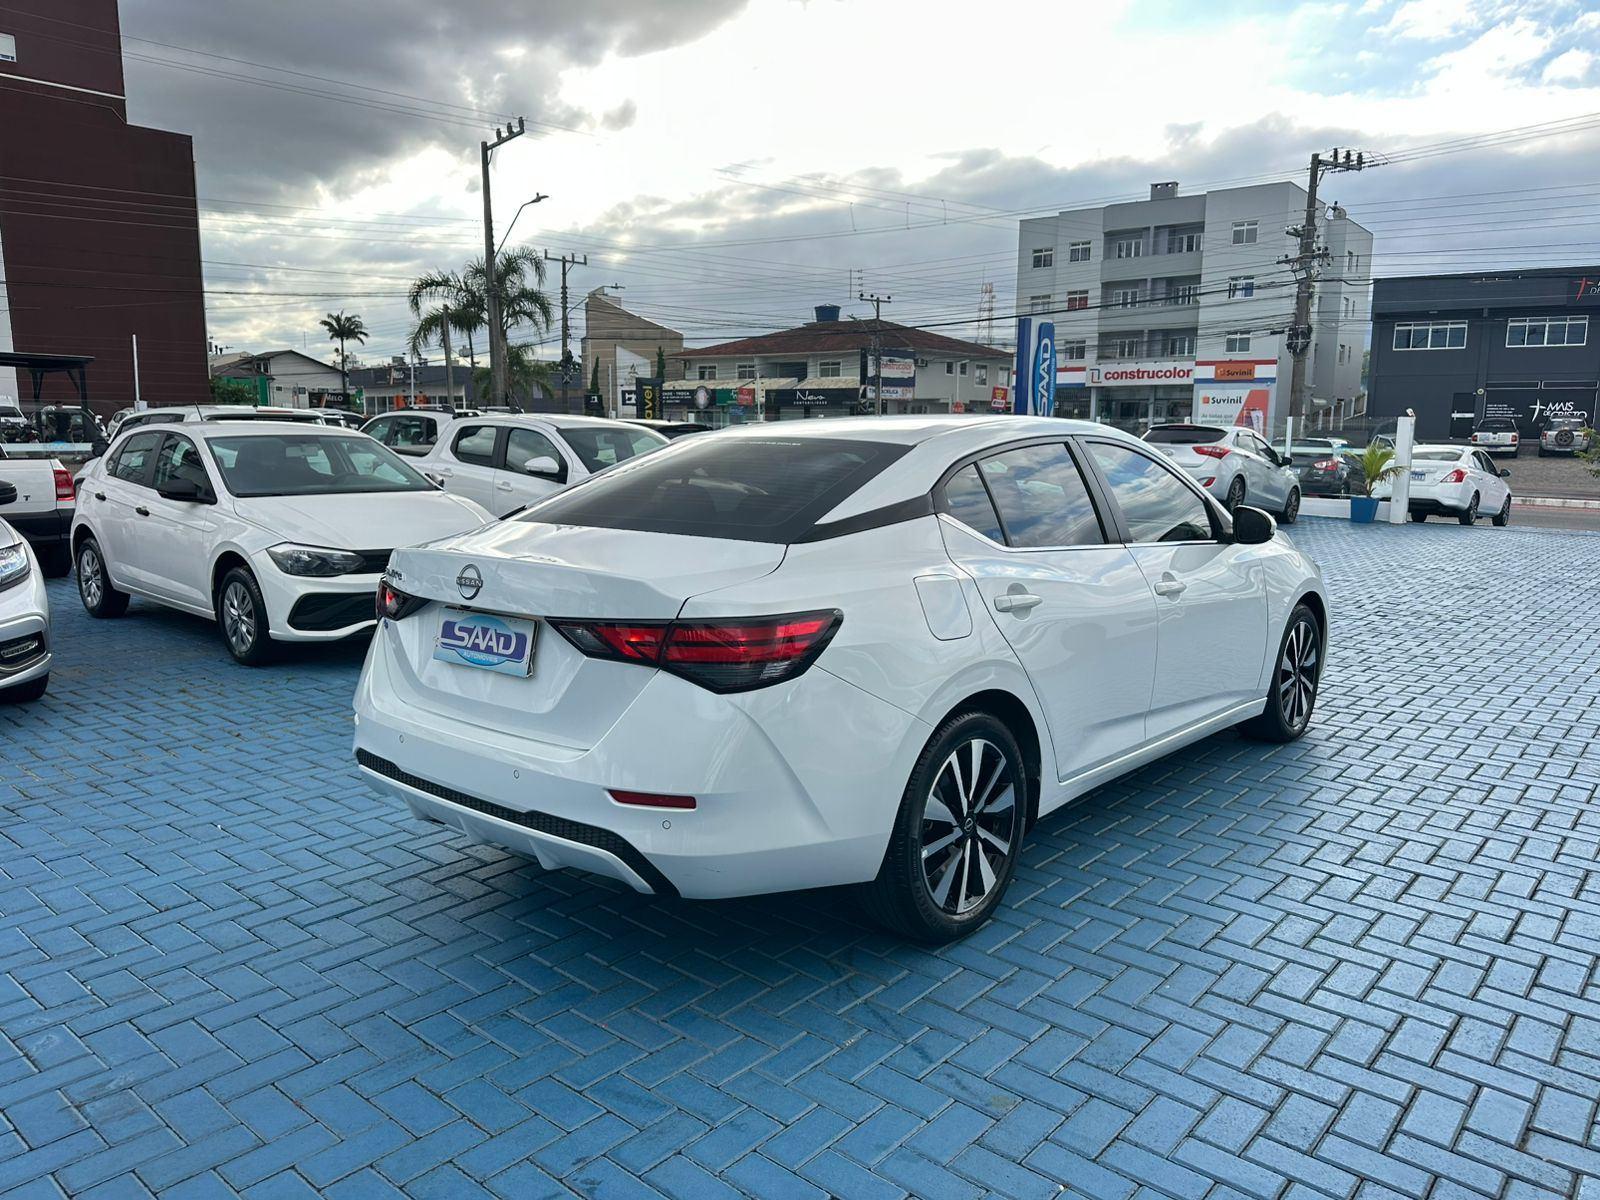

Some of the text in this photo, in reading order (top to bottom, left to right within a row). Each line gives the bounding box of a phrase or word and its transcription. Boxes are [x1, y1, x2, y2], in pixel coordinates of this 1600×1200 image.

[1038, 338, 1051, 416] SAAD
[1104, 366, 1192, 381] construcolor
[1226, 368, 1252, 377] Suvinil
[1211, 396, 1242, 404] Suvinil
[1547, 402, 1574, 411] MAIS
[440, 622, 517, 655] SAAD
